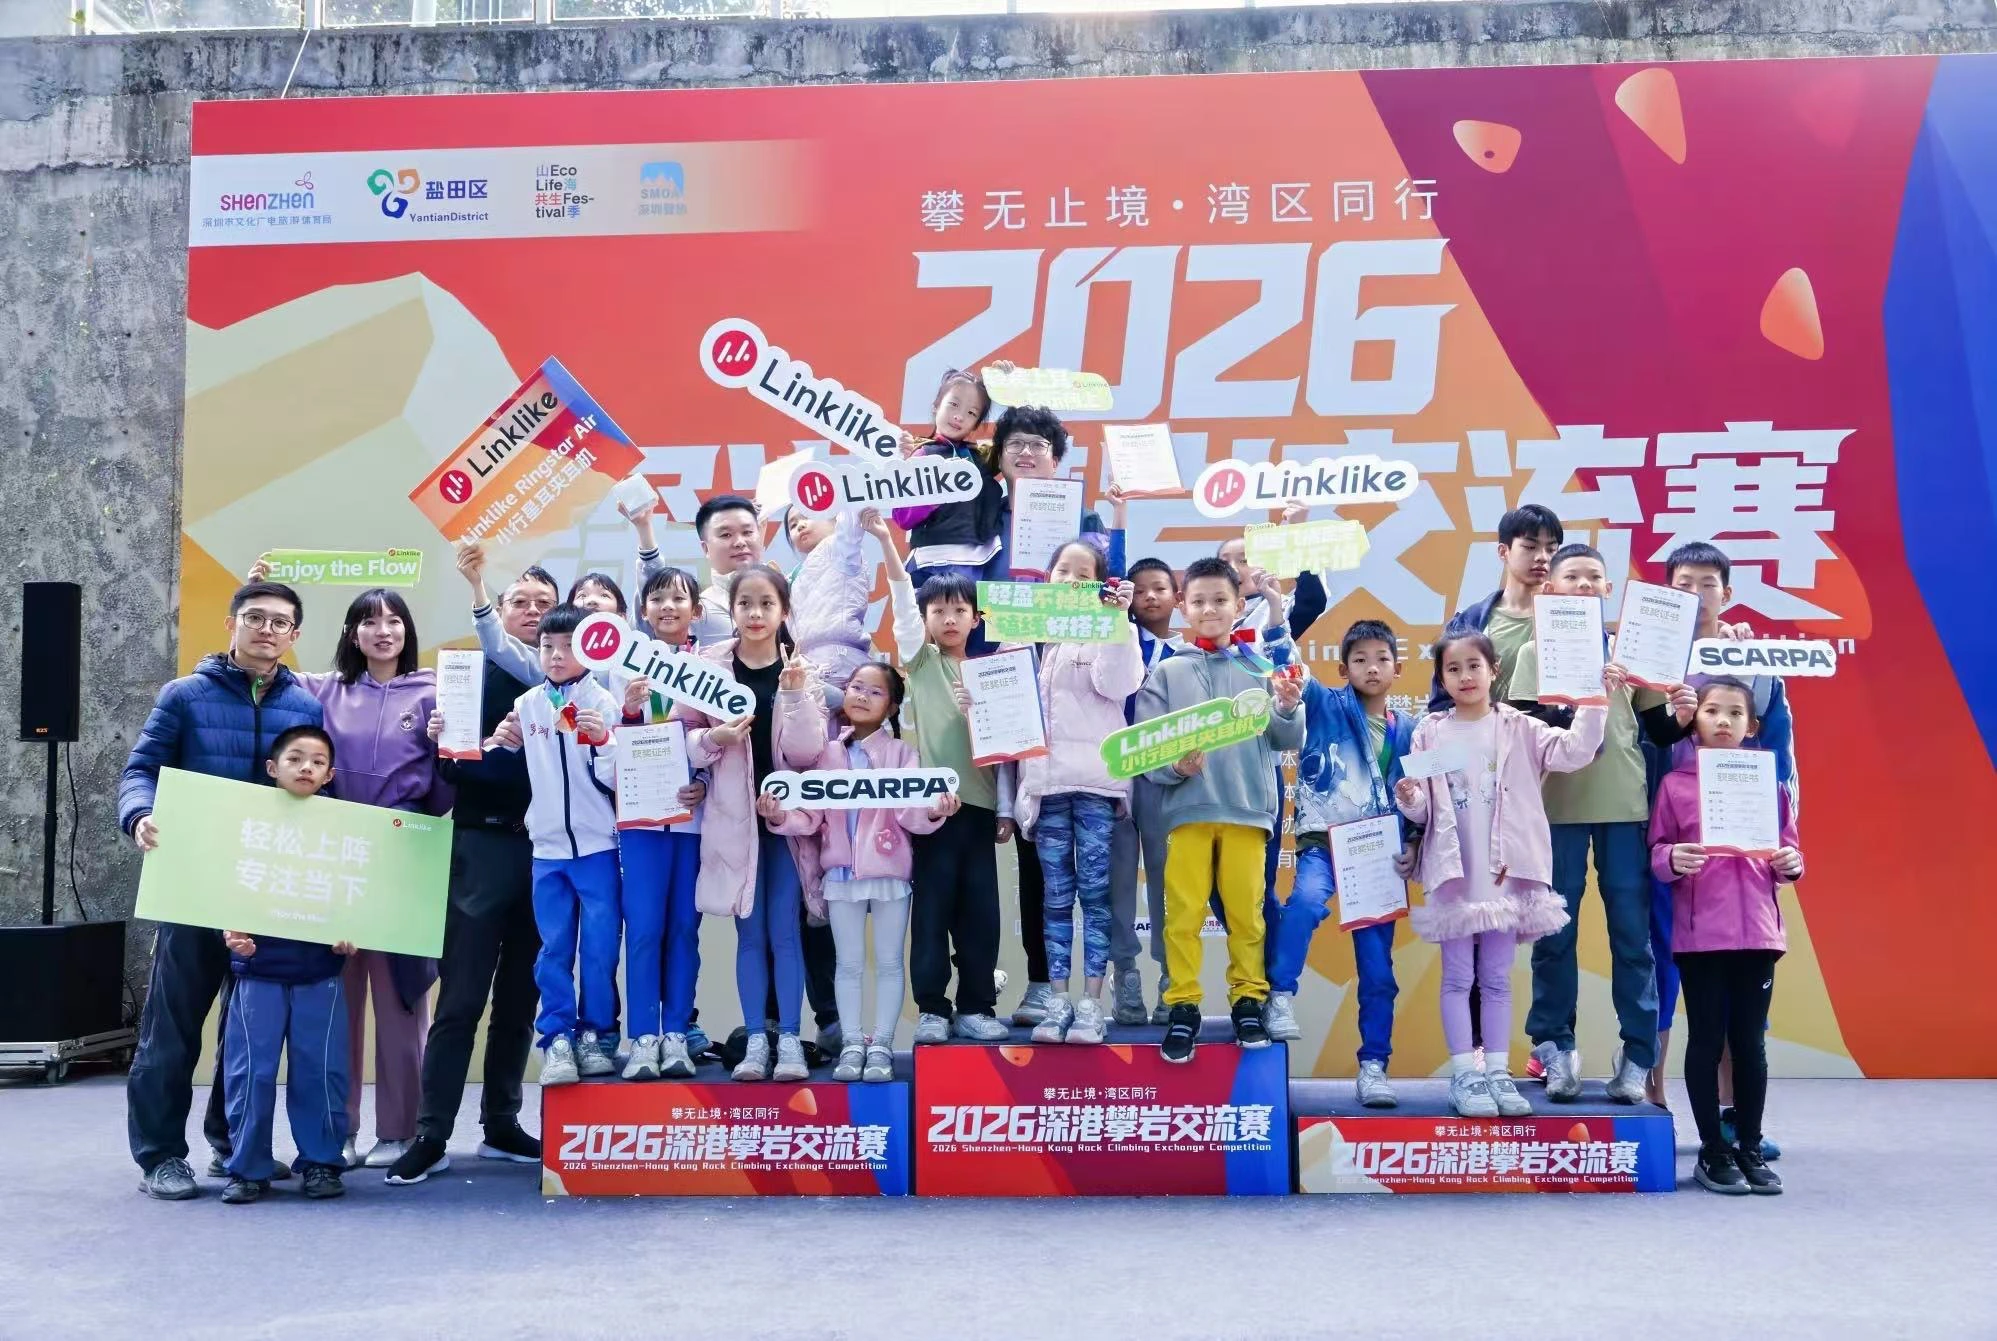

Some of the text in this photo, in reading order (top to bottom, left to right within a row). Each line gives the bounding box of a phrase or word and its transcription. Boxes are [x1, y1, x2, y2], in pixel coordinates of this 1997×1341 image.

[425, 179, 488, 200] 盐田区
[921, 178, 1438, 233] 攀无止境·湾区同行
[900, 237, 1459, 424] 2026
[759, 359, 897, 457] Linklike
[467, 391, 558, 478] Linklike
[460, 413, 598, 546] Linklike Ringstar Air
[495, 447, 597, 545] 小行星耳夹耳机
[842, 466, 974, 503] Linklike
[1255, 463, 1407, 500] Linklike
[269, 558, 416, 582] Enjoy the Flow
[623, 640, 748, 714] Linklike
[1120, 710, 1224, 755] Linklike
[240, 816, 371, 868] 轻松上阵
[236, 857, 367, 905] 专注当下
[1043, 1087, 1157, 1100] 攀无止境·湾区同行
[671, 1107, 780, 1120] 攀无止境·湾区同行
[927, 1104, 1275, 1142] 2026深港攀岩交流赛
[1434, 1125, 1537, 1137] 攀无止境·湾区同行
[559, 1124, 892, 1161] 2026深港攀岩交流赛
[932, 1144, 1272, 1153] 2026 Shenzhen-Hong Kong Rock Climbing Exchange Competition
[1332, 1141, 1639, 1175] 2026深港攀岩交流赛
[563, 1162, 888, 1172] 2026 Shenzhen-Hong Kong Rock Climbing Exchange Competition
[1439, 1176, 1462, 1185] Kong
[1492, 1176, 1531, 1185] Climbing
[1534, 1176, 1580, 1185] Exchange
[1583, 1176, 1639, 1185] Competition
